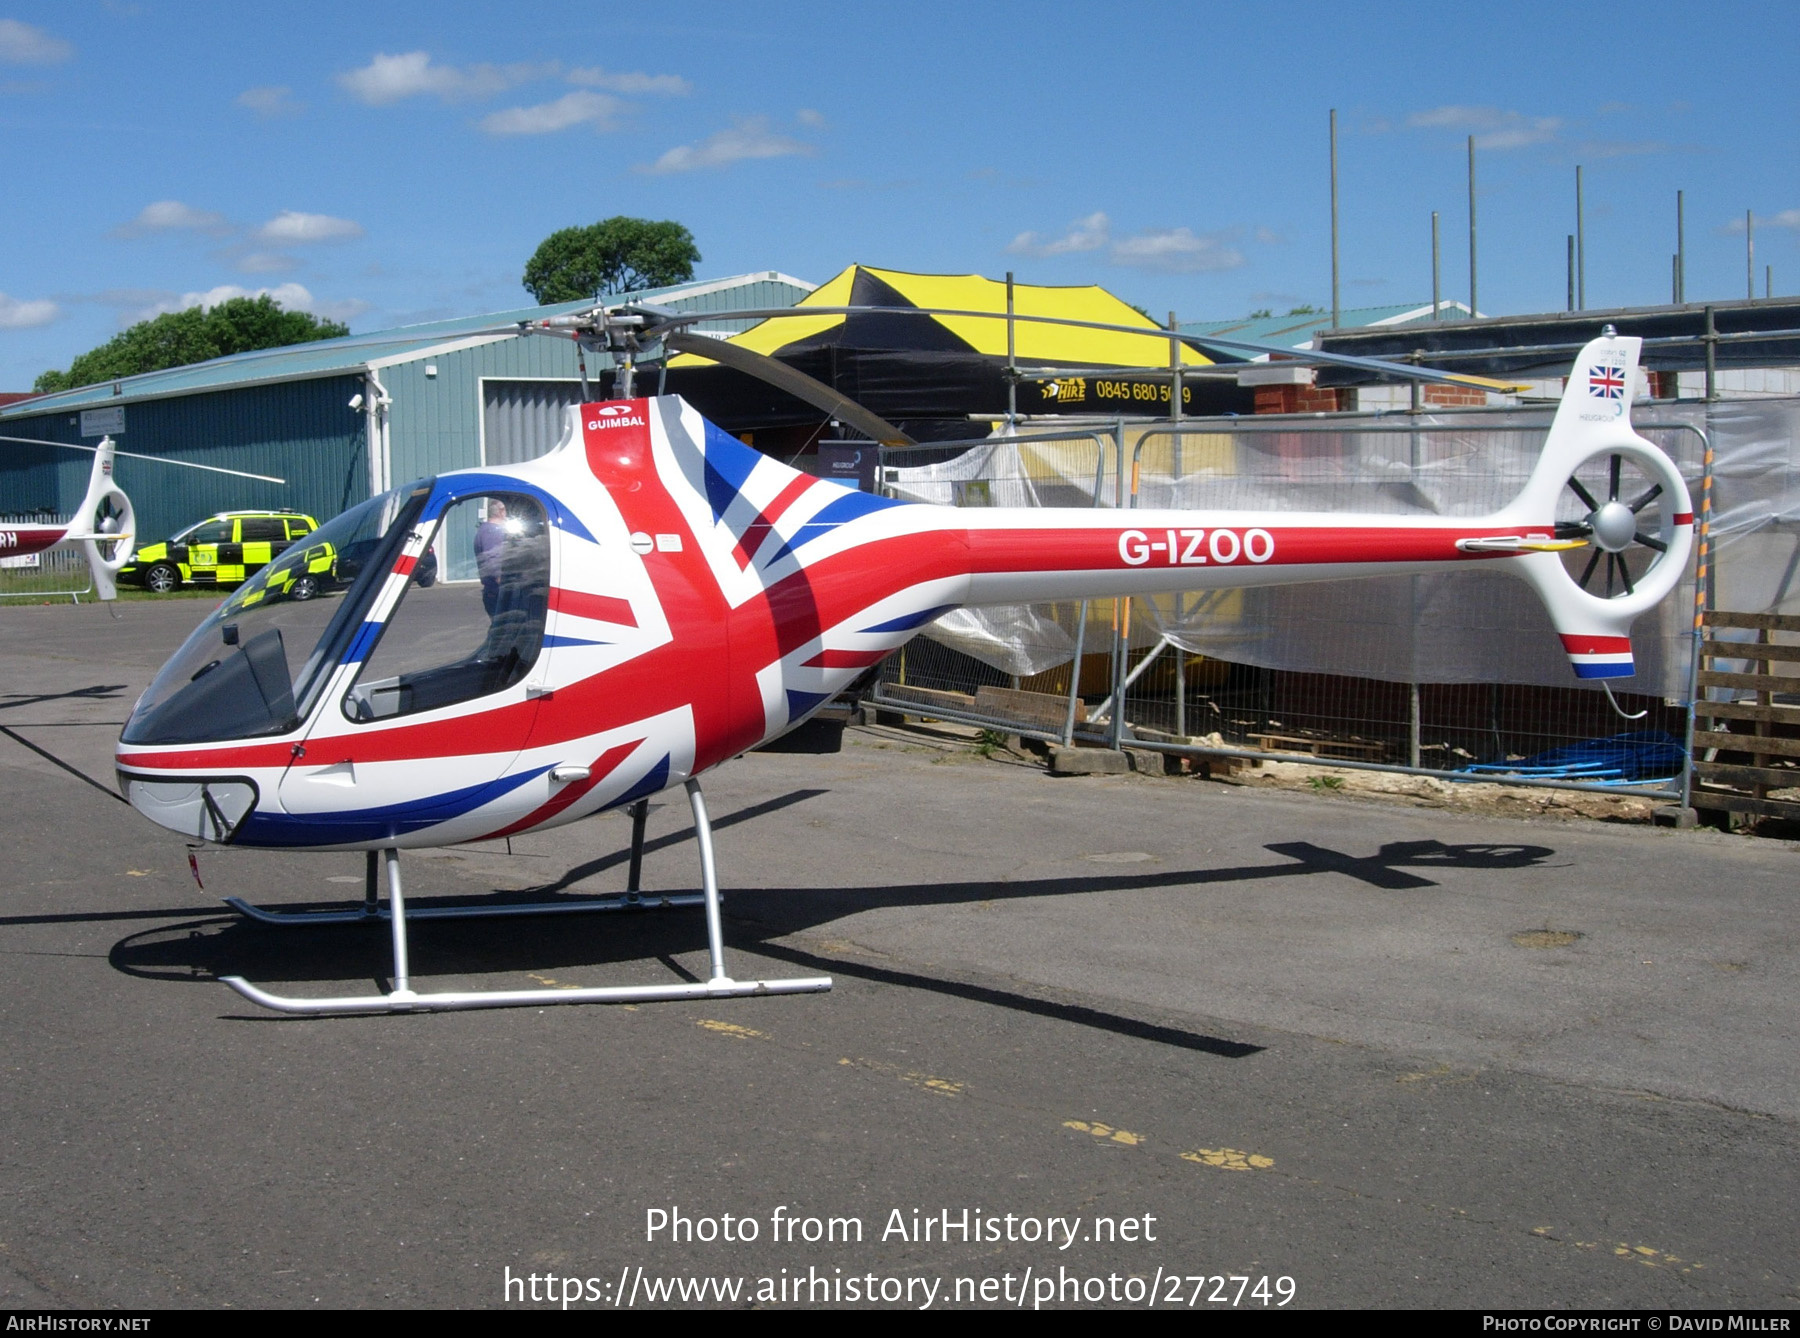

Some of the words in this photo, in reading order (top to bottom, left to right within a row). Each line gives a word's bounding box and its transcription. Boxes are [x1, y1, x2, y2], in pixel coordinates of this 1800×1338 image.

[1057, 384, 1086, 400] HIRE
[1096, 381, 1130, 399] 0845
[1133, 383, 1157, 401] 680
[588, 416, 645, 430] GUIMBAL
[1118, 528, 1275, 566] G-IZOO
